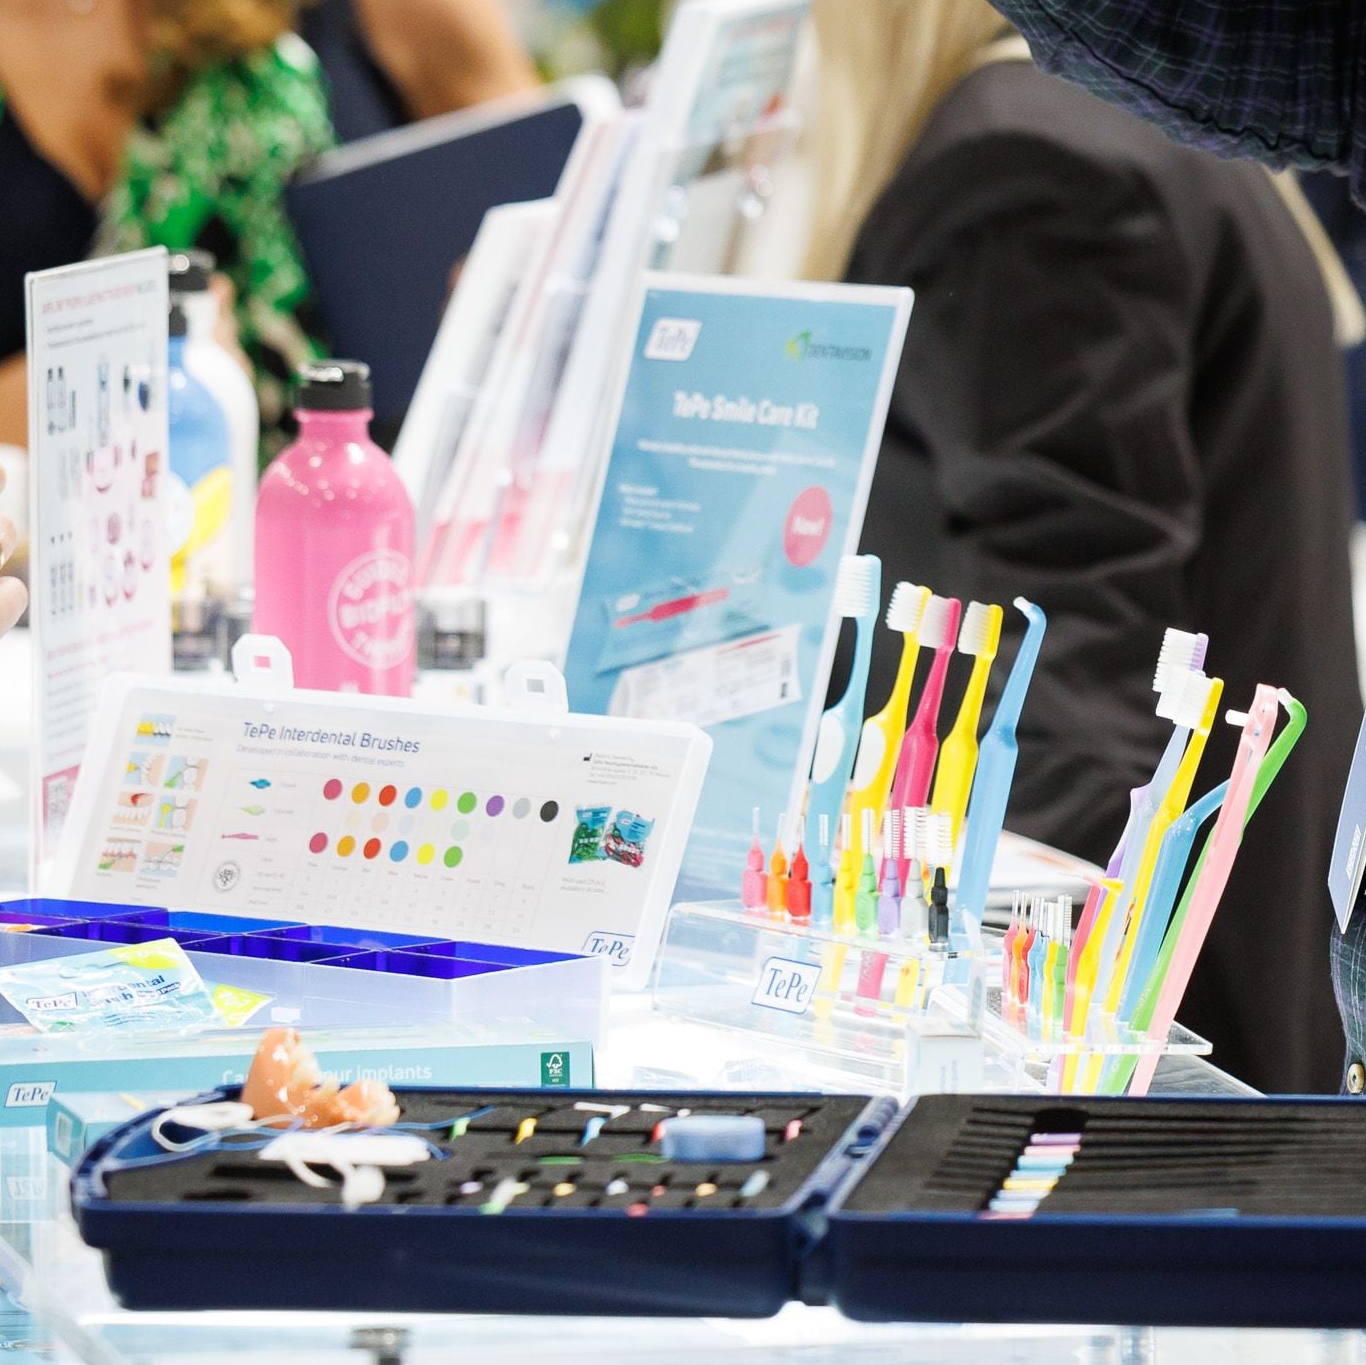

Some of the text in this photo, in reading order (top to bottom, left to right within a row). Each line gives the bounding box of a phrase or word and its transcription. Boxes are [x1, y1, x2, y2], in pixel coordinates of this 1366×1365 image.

[672, 390, 820, 430] TePe Smile Care Kit
[243, 721, 421, 754] TePe Interdental Brushes
[377, 758, 405, 769] experts
[591, 938, 629, 960] TePe
[765, 967, 808, 1004] TePe
[35, 998, 72, 1009] TePe
[356, 1063, 433, 1083] implants
[13, 1086, 49, 1102] TePe
